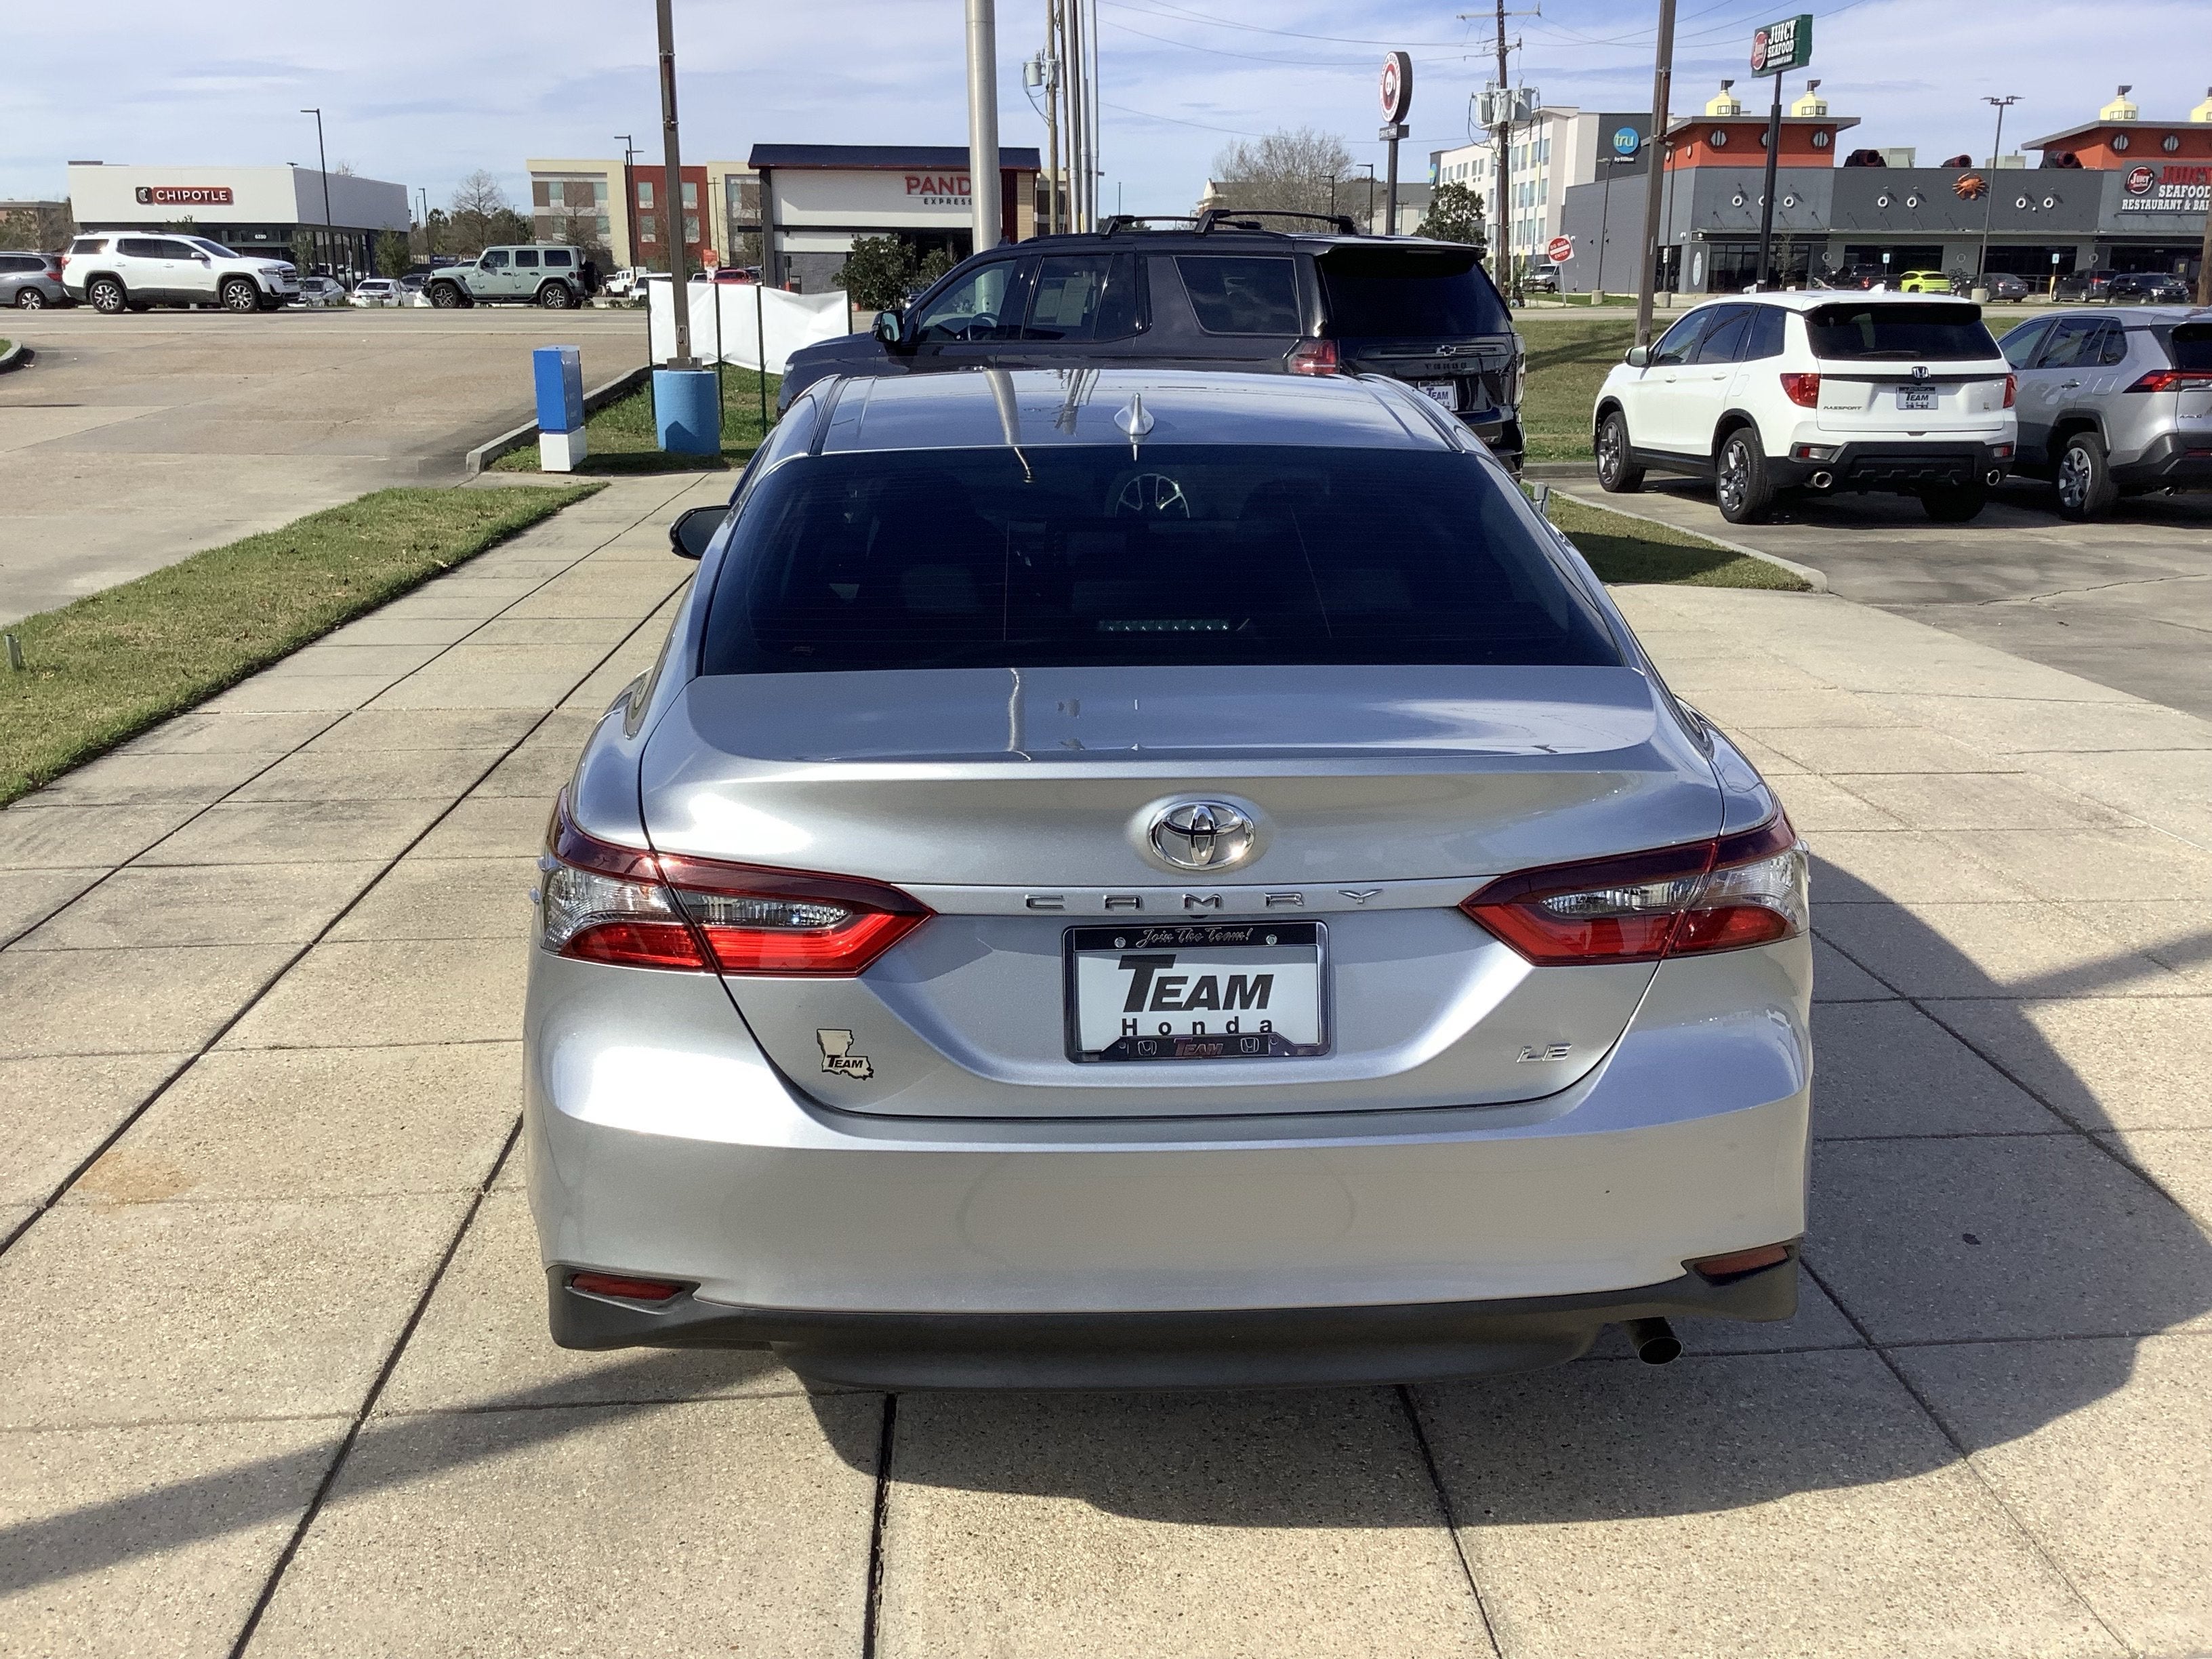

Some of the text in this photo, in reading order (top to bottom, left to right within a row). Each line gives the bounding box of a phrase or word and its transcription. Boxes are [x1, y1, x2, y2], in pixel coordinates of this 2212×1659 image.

[1768, 20, 1796, 45] JUICY
[1767, 39, 1794, 58] SEAFOOD
[1614, 132, 1634, 147] tru
[2158, 166, 2212, 184] JUICY
[157, 190, 228, 201] CHIPOTLE
[905, 176, 971, 196] PAND
[2158, 185, 2211, 198] SEAFOOD
[2122, 199, 2182, 210] RESTAURANT
[2184, 199, 2192, 210] &
[1554, 250, 1568, 260] ENTER
[1906, 391, 1929, 401] TEAM
[1025, 888, 1384, 910] CAMRY
[1135, 926, 1253, 948] Join The Team!
[1118, 954, 1275, 1012] TEAM
[1122, 1016, 1273, 1036] Honda
[1173, 1037, 1224, 1057] TEAM
[1517, 1043, 1572, 1063] LE
[827, 1054, 863, 1069] TEAM
